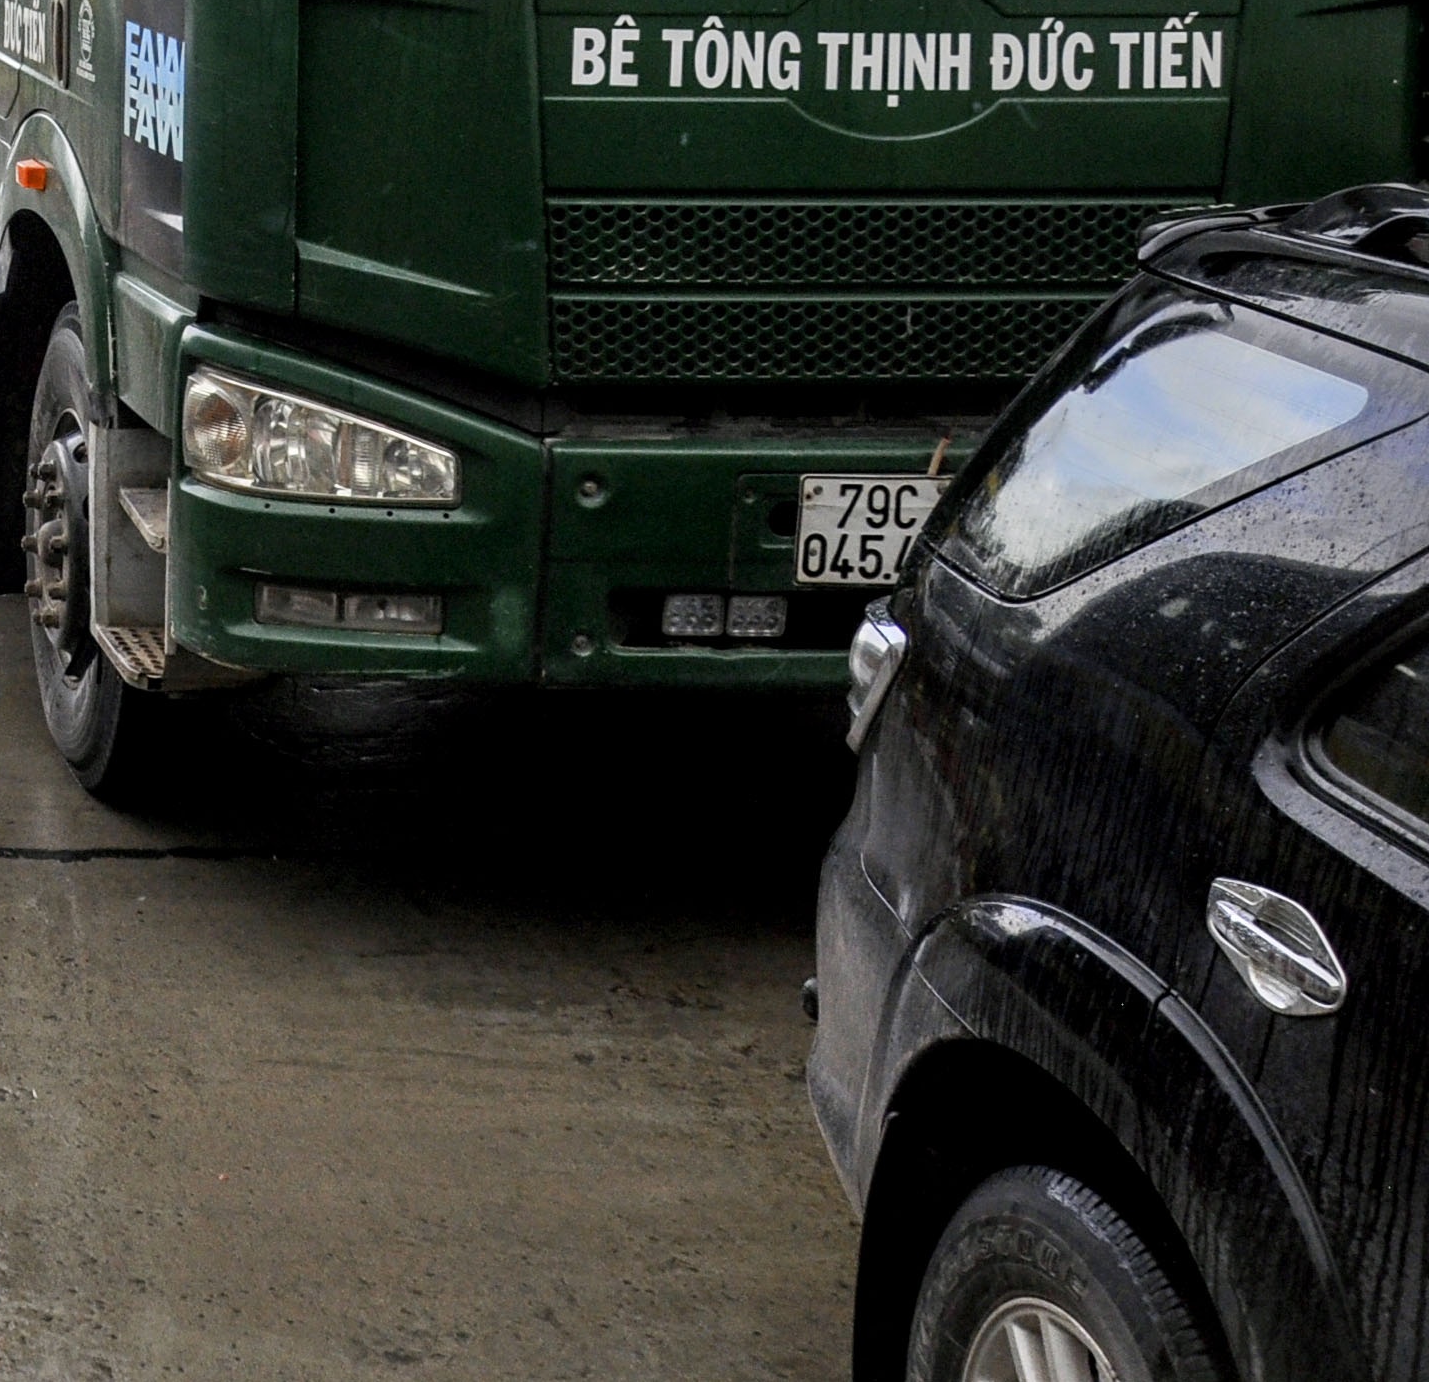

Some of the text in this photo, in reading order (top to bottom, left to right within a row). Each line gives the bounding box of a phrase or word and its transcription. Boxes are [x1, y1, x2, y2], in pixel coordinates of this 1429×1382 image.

[571, 11, 1223, 108] BÊ TÔNG THỊNH ĐỨC TIẾN
[837, 484, 919, 529] 79C
